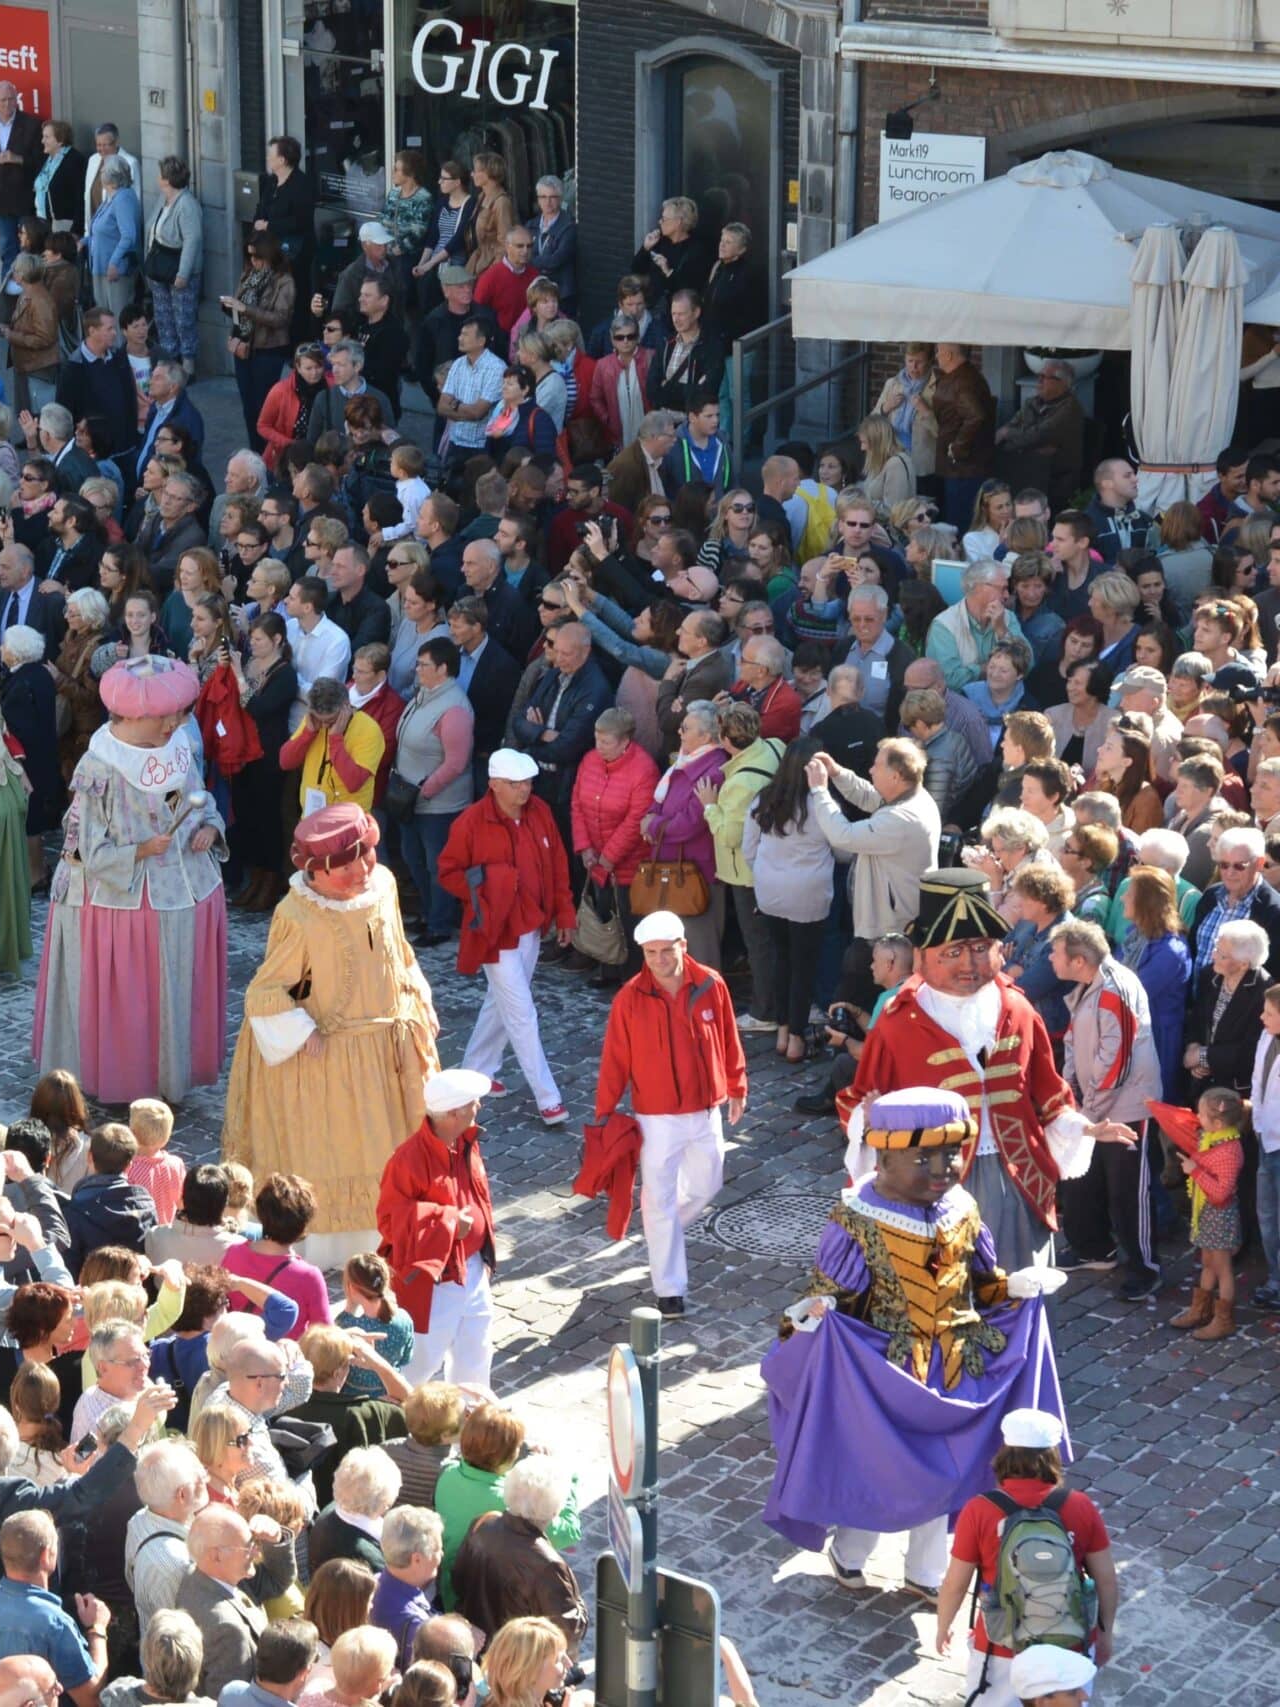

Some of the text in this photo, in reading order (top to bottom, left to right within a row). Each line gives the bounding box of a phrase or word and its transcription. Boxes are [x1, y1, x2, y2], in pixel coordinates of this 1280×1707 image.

[412, 18, 560, 110] GIGI
[888, 143, 929, 159] Markt19
[888, 164, 975, 185] Lunchroom
